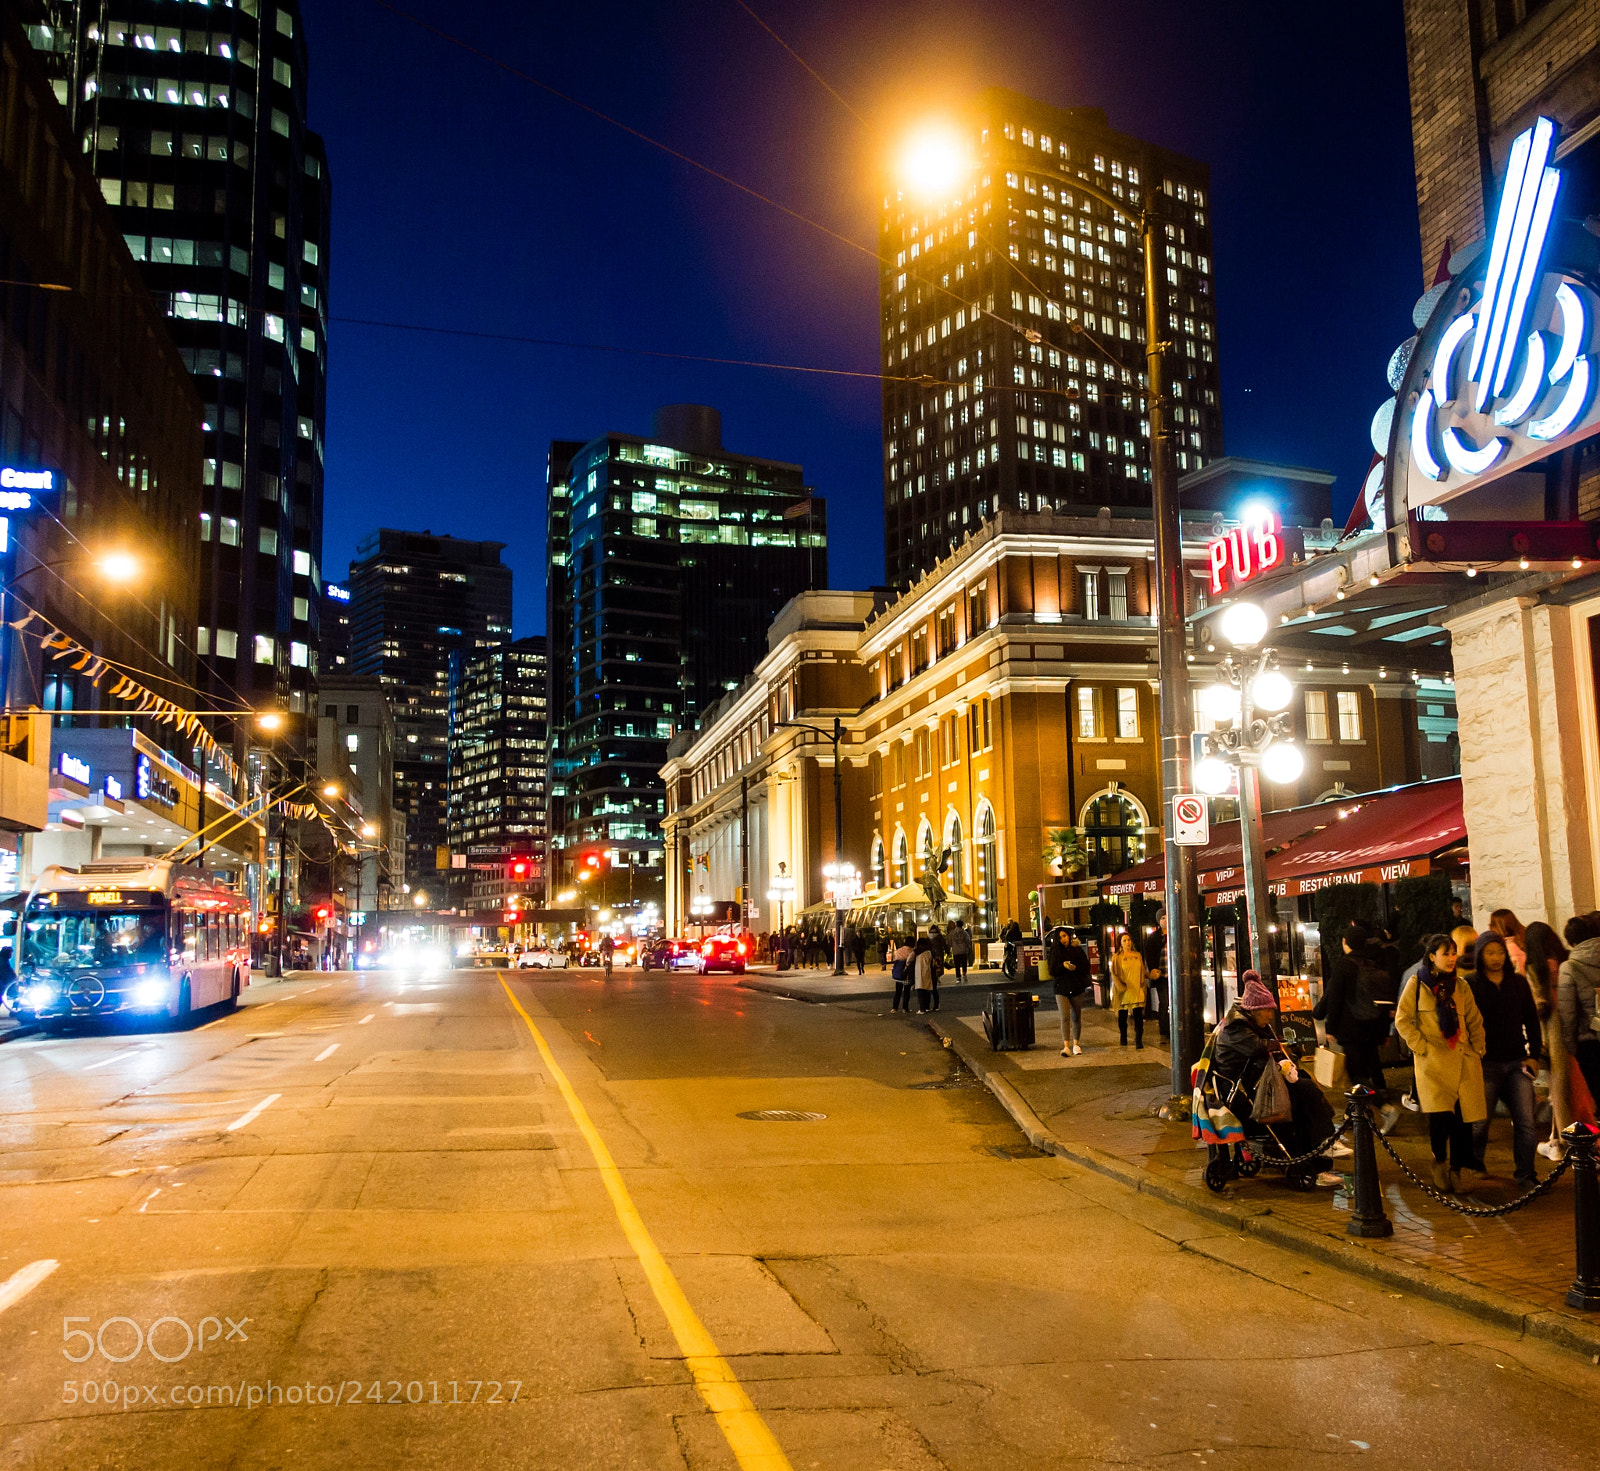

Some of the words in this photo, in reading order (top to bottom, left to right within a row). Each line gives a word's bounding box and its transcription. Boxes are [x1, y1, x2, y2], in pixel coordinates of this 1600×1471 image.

[1209, 511, 1280, 595] PUB
[1299, 871, 1363, 893] RESTAURANT
[1380, 863, 1410, 881] VIEW
[1110, 883, 1136, 894] BREWERY
[1144, 880, 1156, 891] PUB
[1268, 883, 1287, 896] PUB
[48, 891, 58, 907] 4
[88, 891, 123, 905] POWELL
